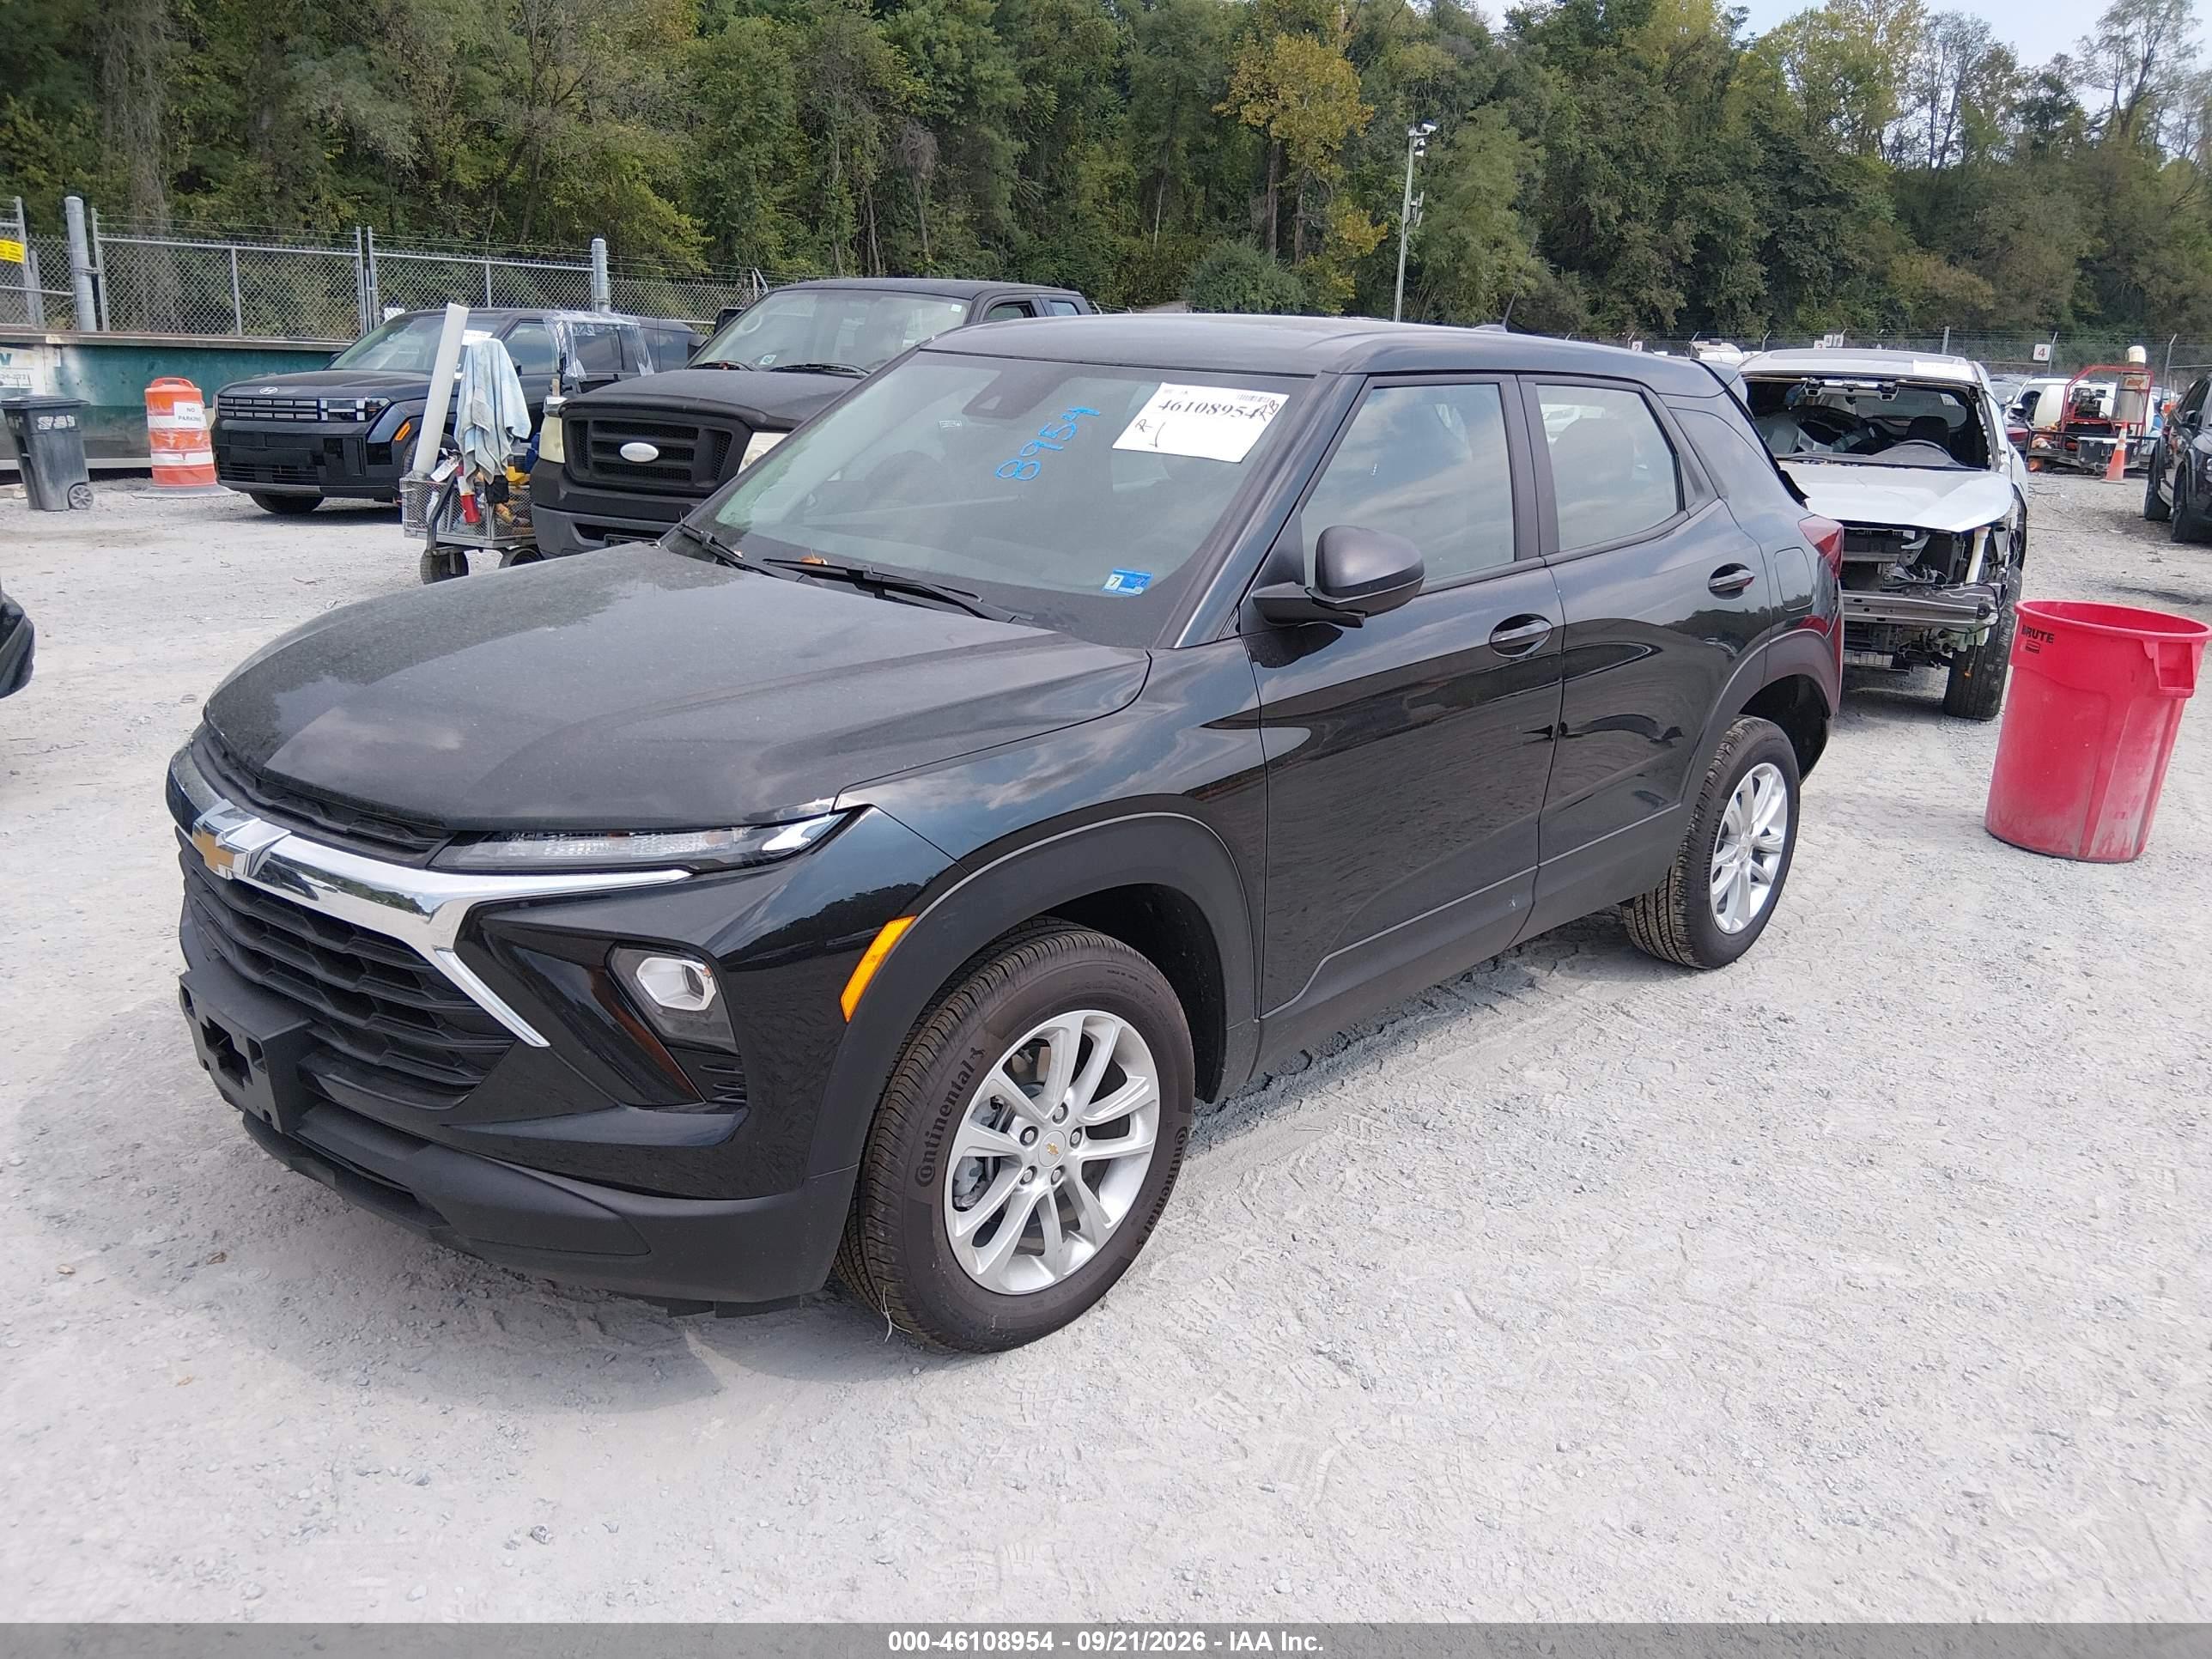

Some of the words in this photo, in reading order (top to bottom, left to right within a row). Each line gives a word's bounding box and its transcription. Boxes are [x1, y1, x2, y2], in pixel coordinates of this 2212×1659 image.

[2038, 348, 2046, 357] 4
[1158, 399, 1261, 420] 46108954
[995, 405, 1101, 481] 8954
[1110, 576, 1120, 586] 7
[2021, 624, 2055, 644] BRUTE
[915, 1059, 975, 1188] Continental
[1143, 1126, 1188, 1235] Continental
